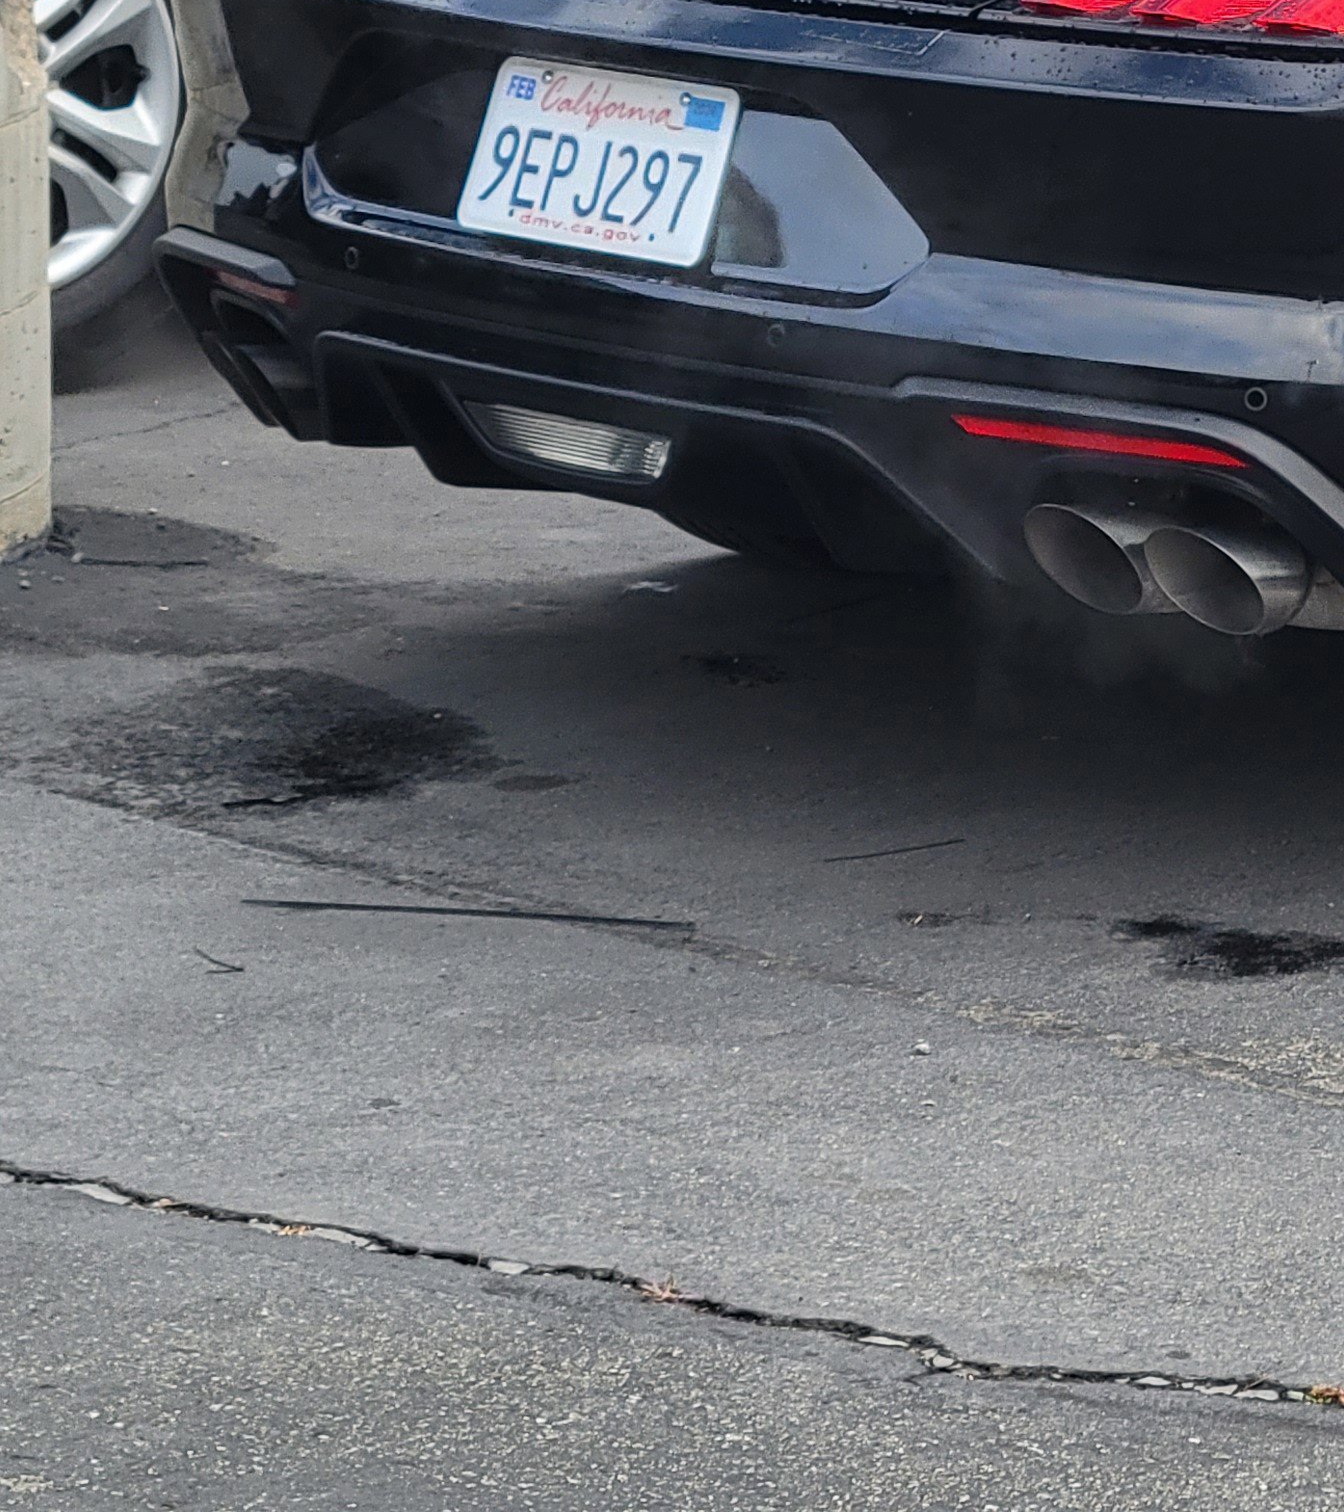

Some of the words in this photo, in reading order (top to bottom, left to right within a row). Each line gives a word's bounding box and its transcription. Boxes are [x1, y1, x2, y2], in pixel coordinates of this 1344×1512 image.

[506, 75, 536, 100] FEB
[540, 75, 684, 131] California
[477, 124, 704, 234] 9EPJ297
[519, 211, 642, 243] dmv.ca.gov
